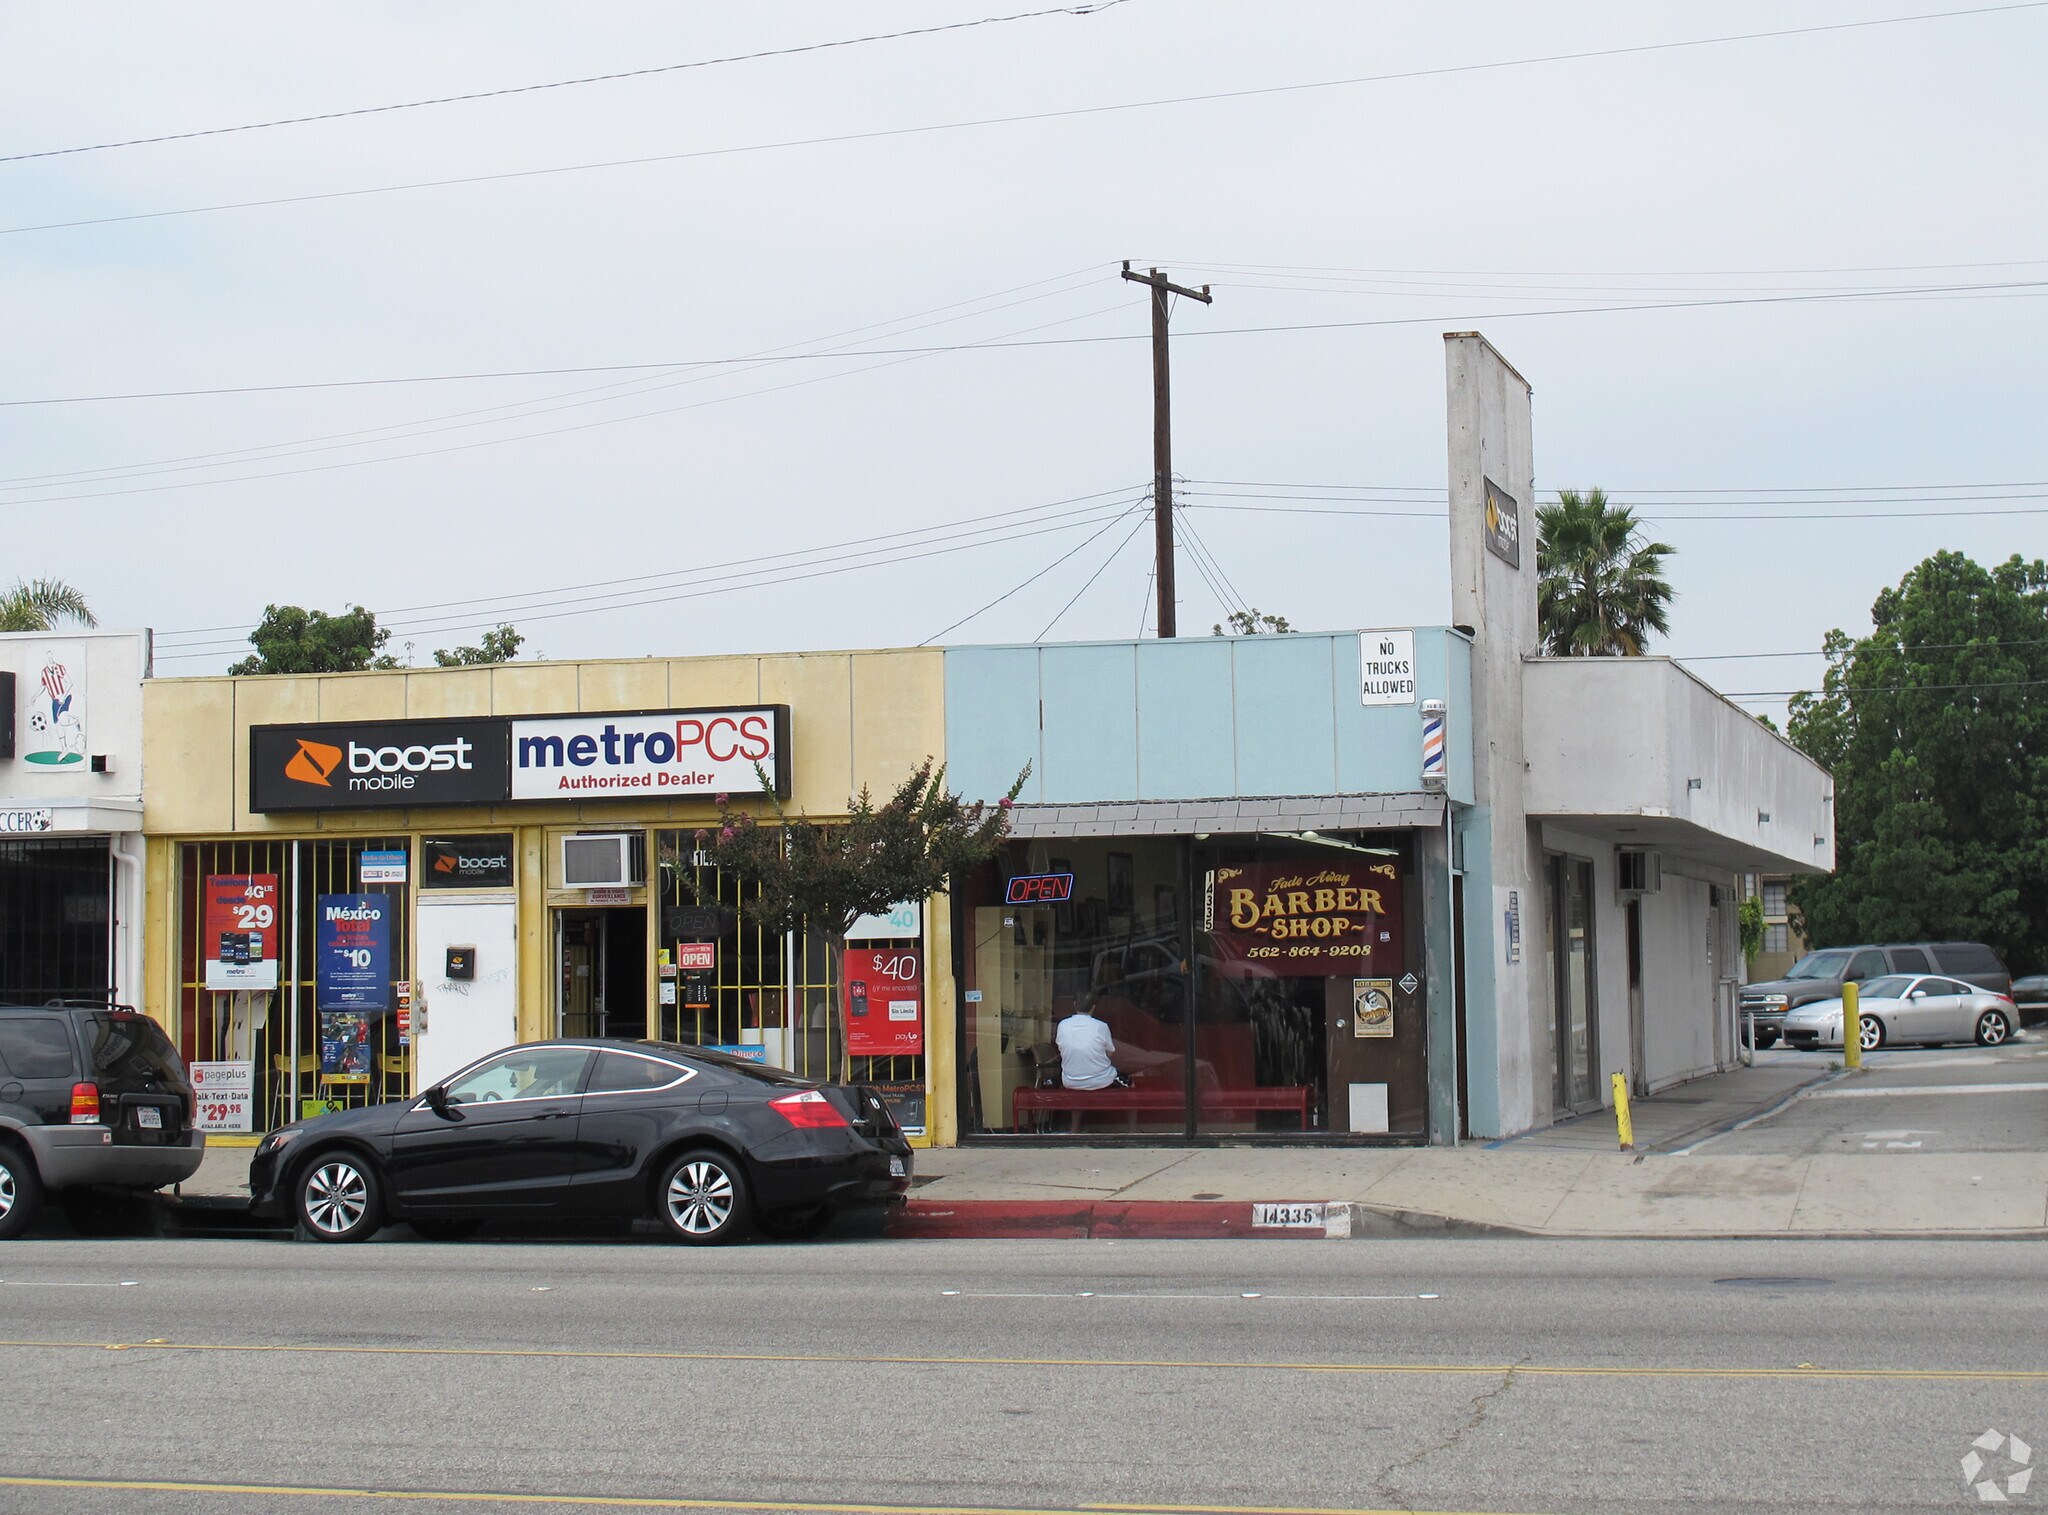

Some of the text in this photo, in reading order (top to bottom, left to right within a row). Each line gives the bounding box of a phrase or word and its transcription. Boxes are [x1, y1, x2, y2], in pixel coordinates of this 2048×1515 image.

[1380, 642, 1395, 655] NO
[1366, 661, 1409, 675] TRUCKS
[1363, 680, 1413, 695] ALLOWED
[518, 717, 770, 768] metroPCS
[348, 737, 473, 774] boost
[558, 771, 715, 790] Authorized Dealer
[458, 855, 507, 868] boost
[1010, 876, 1070, 901] OPEN
[1268, 870, 1351, 893] Fade Away
[1203, 872, 1214, 930] 14335
[1229, 887, 1388, 929] BARBER
[326, 907, 381, 921] México
[335, 919, 371, 932] Total
[683, 953, 711, 966] OPEN
[1247, 945, 1373, 958] 562-864-9208
[872, 953, 917, 981] $40
[204, 1069, 247, 1081] pageplus
[1263, 1207, 1313, 1224] 14335
